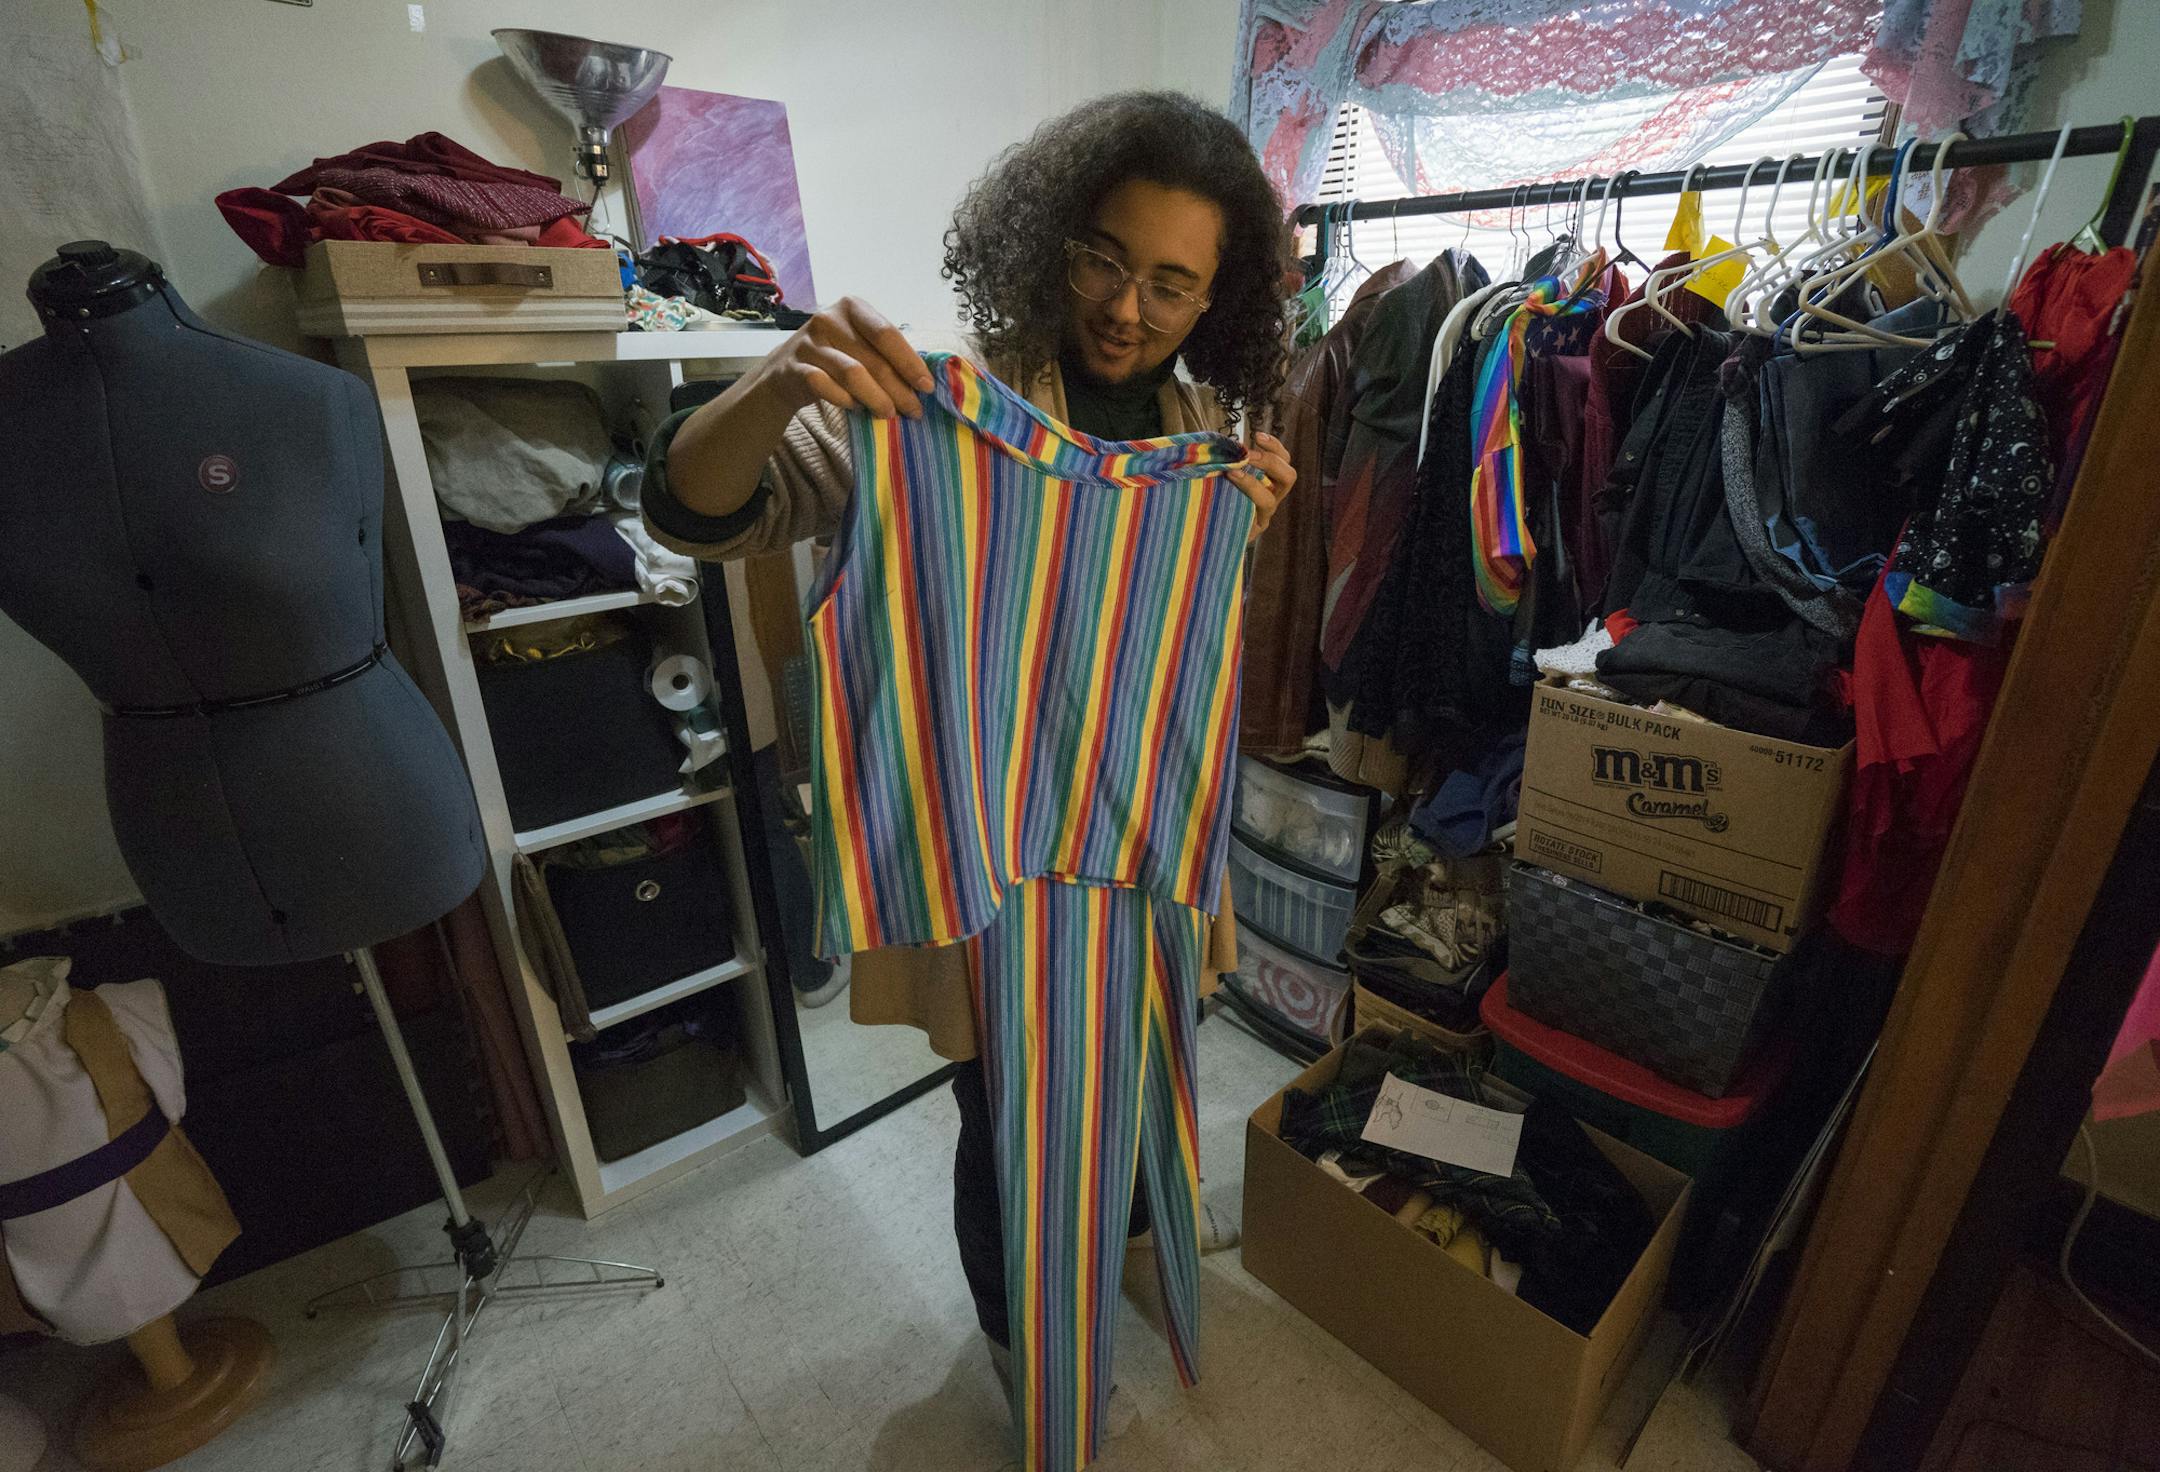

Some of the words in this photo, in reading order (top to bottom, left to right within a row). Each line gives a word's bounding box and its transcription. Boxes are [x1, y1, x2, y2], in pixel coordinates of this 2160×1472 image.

[208, 464, 231, 485] S
[1540, 696, 1566, 711] FUN
[1607, 711, 1643, 732] BULK
[1644, 721, 1682, 741] PACK
[1593, 746, 1720, 793] m&m's
[1627, 792, 1709, 819] Caramel
